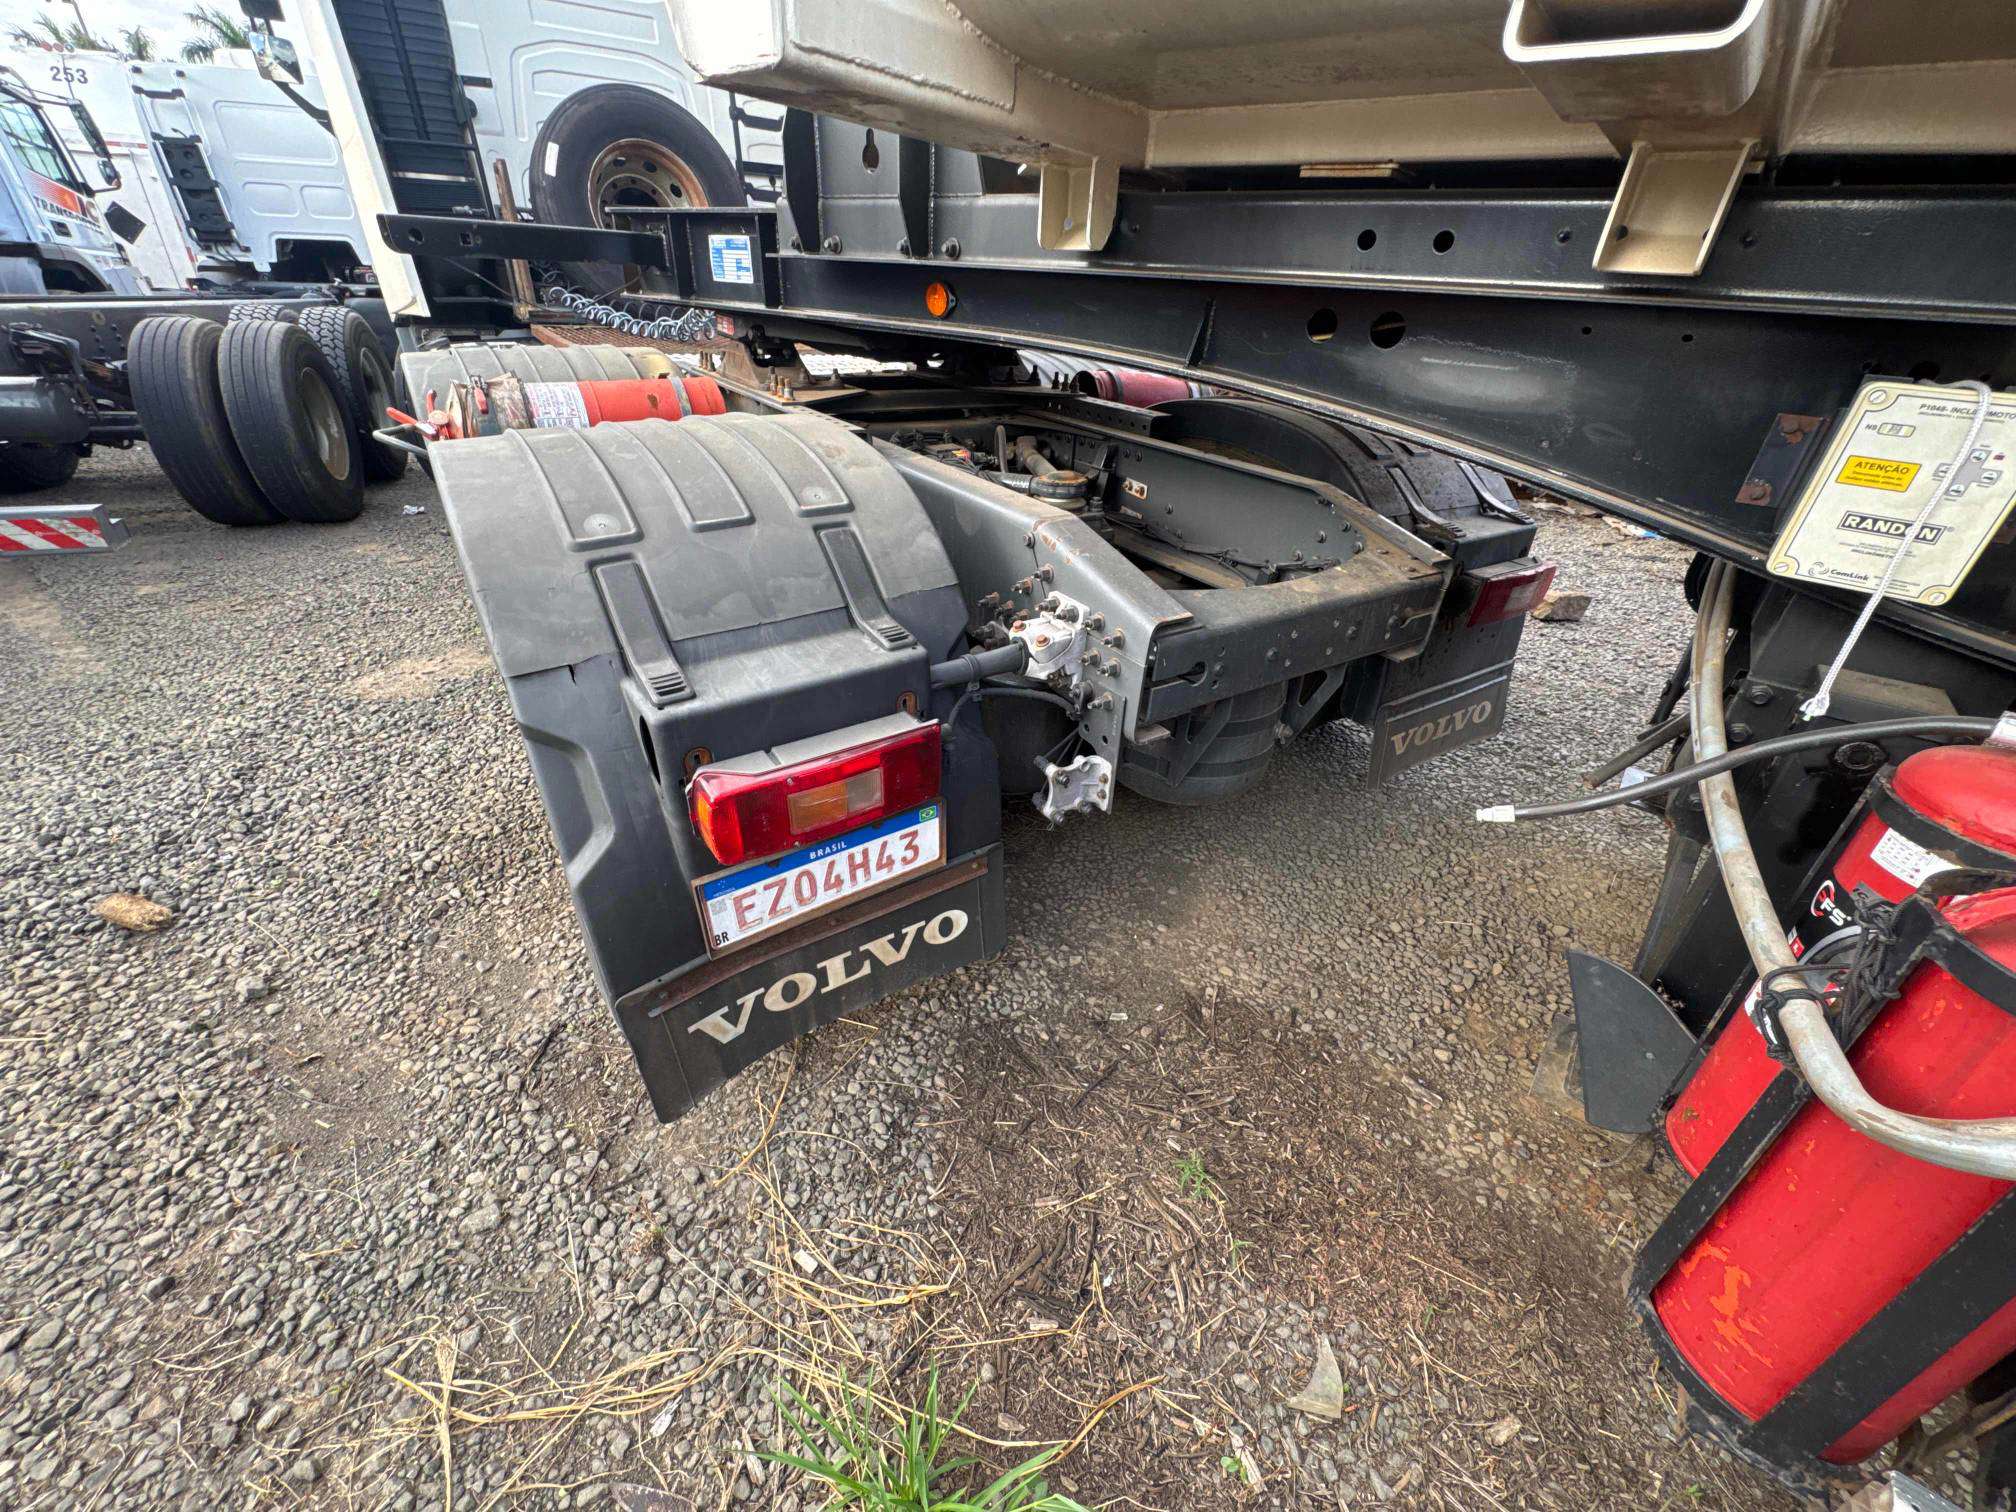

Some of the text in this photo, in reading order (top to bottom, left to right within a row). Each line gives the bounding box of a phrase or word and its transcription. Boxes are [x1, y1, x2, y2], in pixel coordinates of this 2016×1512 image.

[50, 65, 89, 84] 253
[1854, 460, 1910, 475] ATENÇÃO
[1830, 568, 1870, 582] ComLink
[1391, 700, 1492, 755] VOLVO
[809, 840, 848, 860] BRASIL
[732, 829, 921, 933] EZ04H43
[714, 931, 730, 946] BR
[687, 909, 969, 1044] VOLVO
